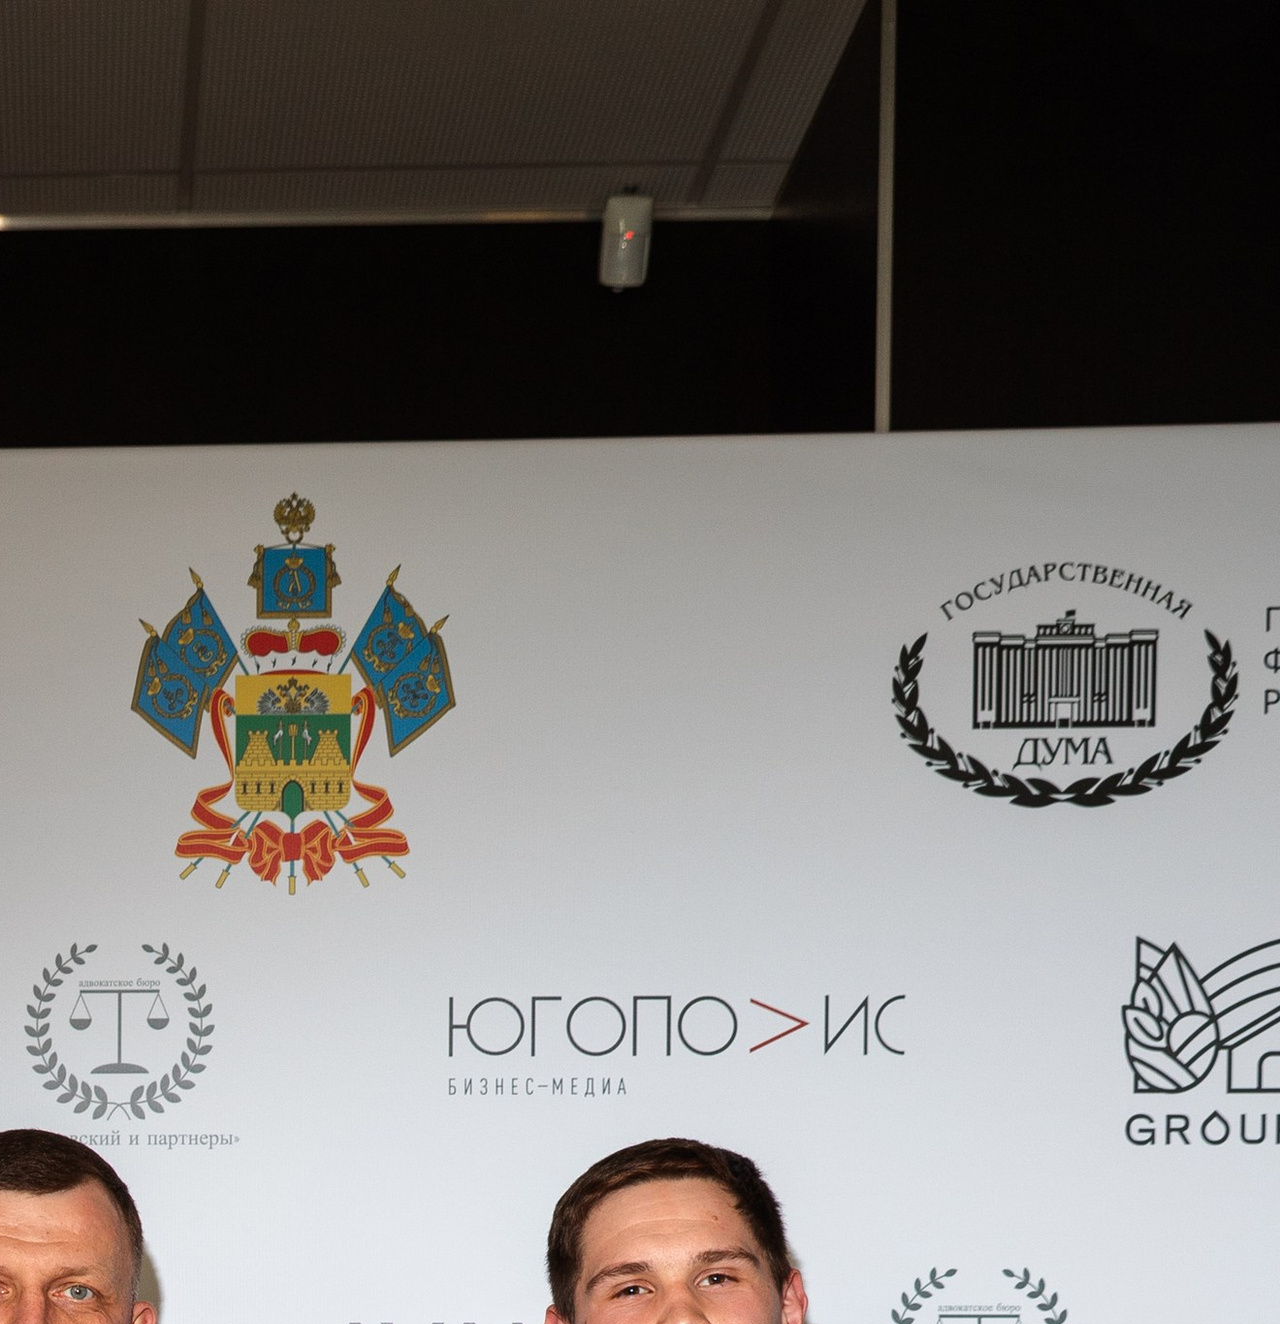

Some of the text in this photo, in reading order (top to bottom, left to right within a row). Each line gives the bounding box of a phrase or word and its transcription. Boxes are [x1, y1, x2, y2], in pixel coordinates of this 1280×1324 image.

[939, 562, 1193, 621] ГОСУДАРСТВЕННАЯ
[1012, 736, 1114, 771] ДУМА
[78, 977, 161, 989] адвокатское бюро
[448, 1077, 627, 1098] БИЗНЕС-МЕДИА
[128, 1133, 139, 1146] и
[1125, 1110, 1280, 1146] GROU
